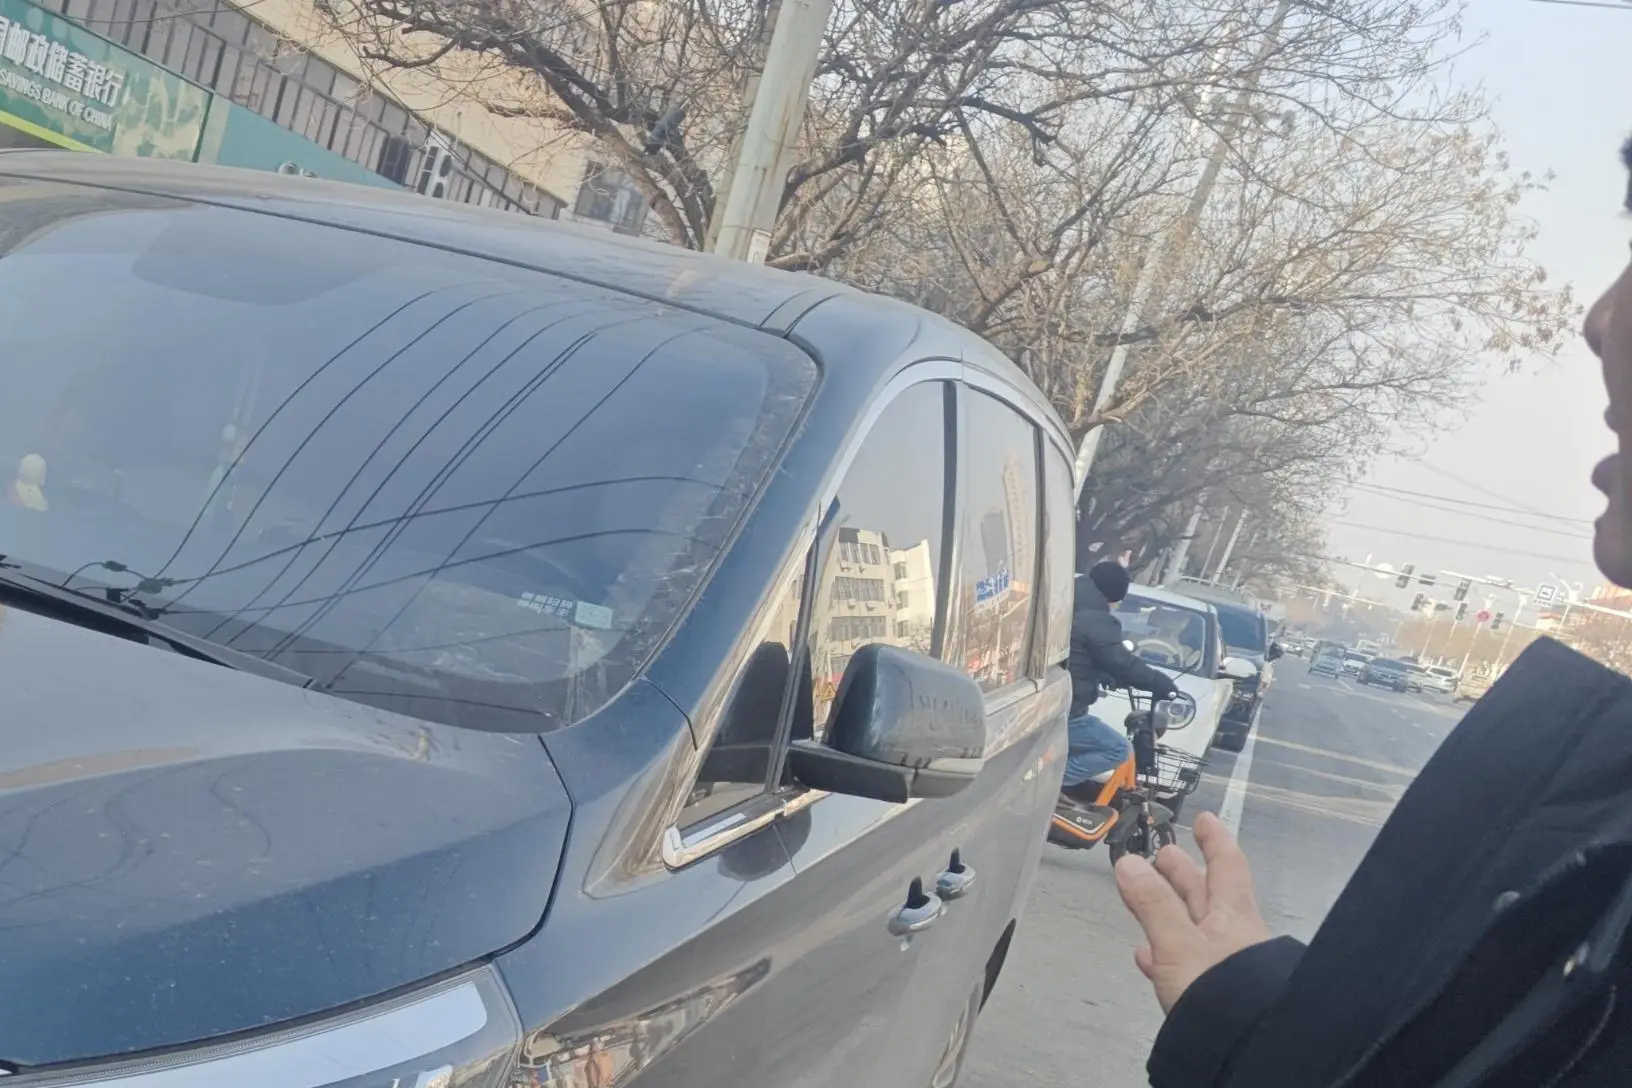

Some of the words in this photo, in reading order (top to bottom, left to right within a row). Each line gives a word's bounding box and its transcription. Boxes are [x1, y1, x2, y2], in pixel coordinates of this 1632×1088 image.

[40, 87, 70, 113] BANK
[68, 100, 86, 117] OF
[82, 107, 113, 132] CHINA
